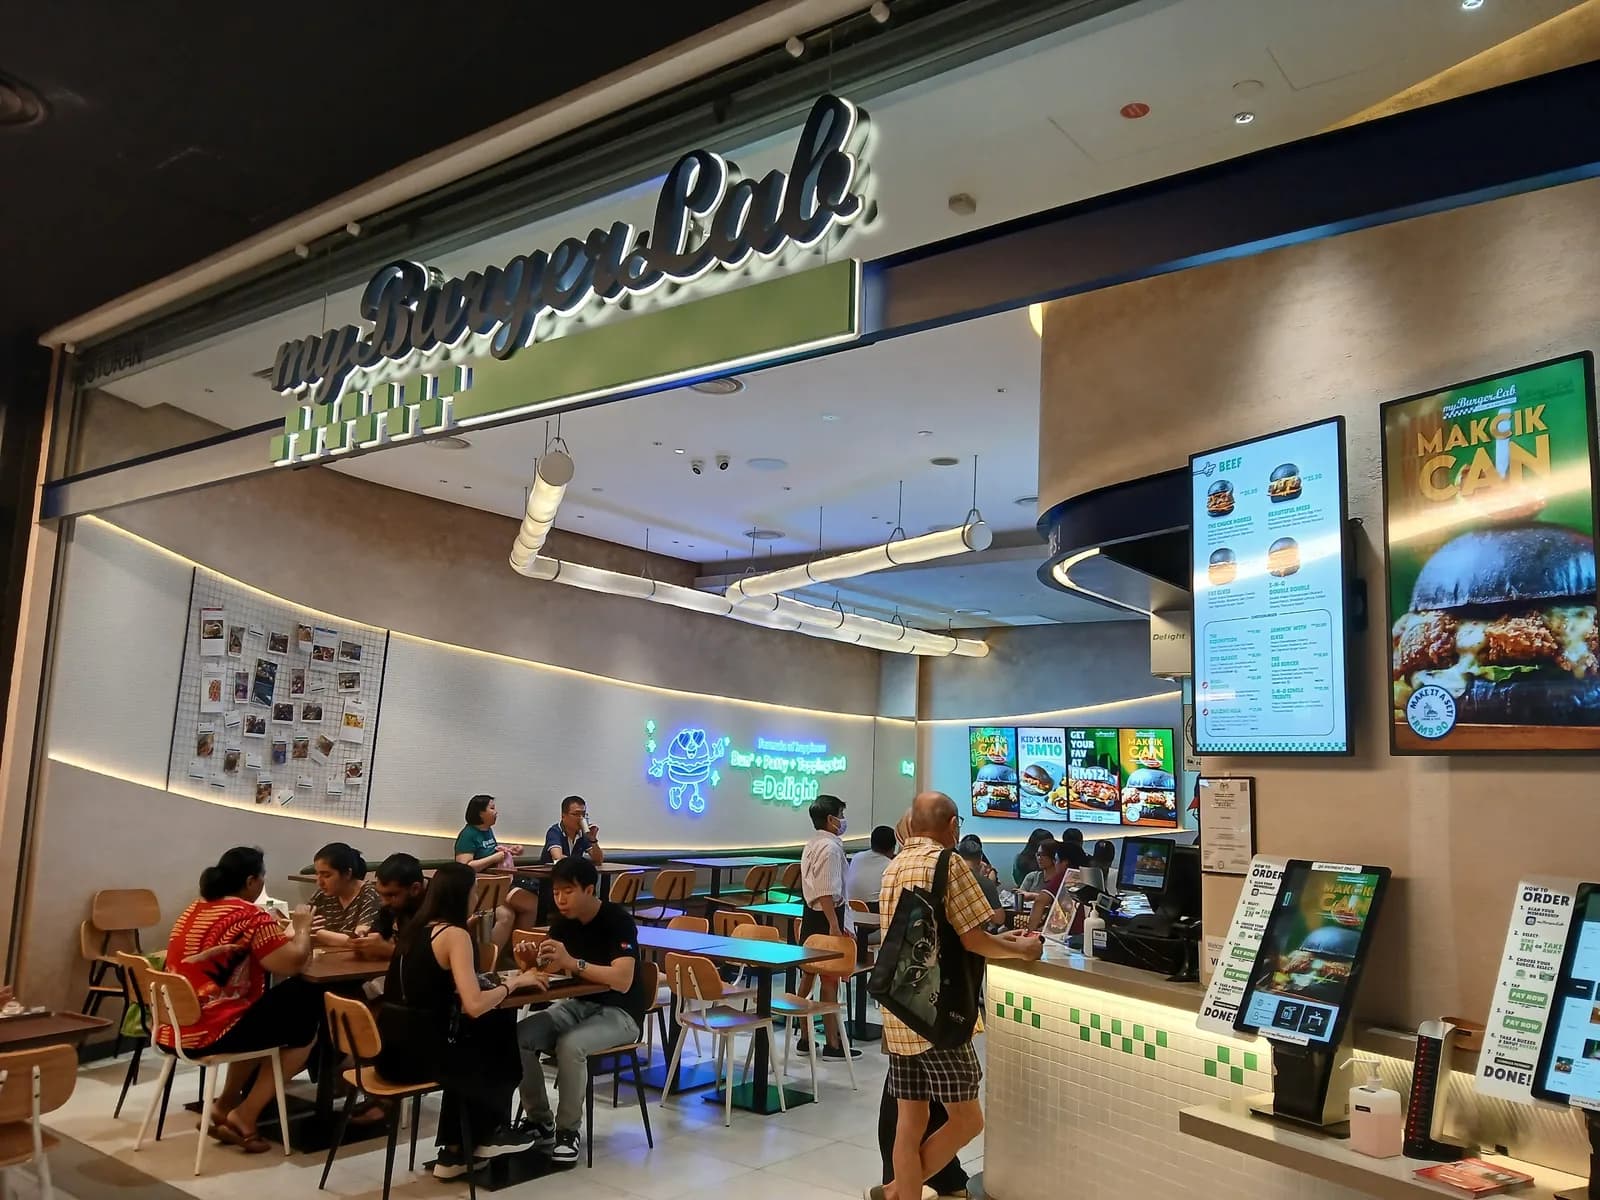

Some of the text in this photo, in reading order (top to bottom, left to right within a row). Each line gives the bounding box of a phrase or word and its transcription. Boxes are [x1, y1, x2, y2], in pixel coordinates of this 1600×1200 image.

[271, 94, 863, 404] myBurgerLab
[1443, 384, 1516, 412] myBurgerLab
[1417, 403, 1549, 457] MAKCIK
[1219, 456, 1242, 472] BEEF
[1420, 434, 1551, 501] CAN
[1410, 689, 1430, 710] MAKE
[1021, 736, 1062, 744] KID'S MEAL
[1070, 731, 1086, 739] GET
[1070, 740, 1094, 748] YOUR
[1071, 750, 1086, 758] FAV
[1128, 746, 1164, 759] CAN
[1072, 759, 1082, 767] AT
[1072, 768, 1108, 780] RM12!
[1522, 892, 1570, 906] ORDER
[1520, 943, 1533, 952] IN
[1204, 1007, 1236, 1022] DONE!
[1484, 1066, 1532, 1086] DONE!
